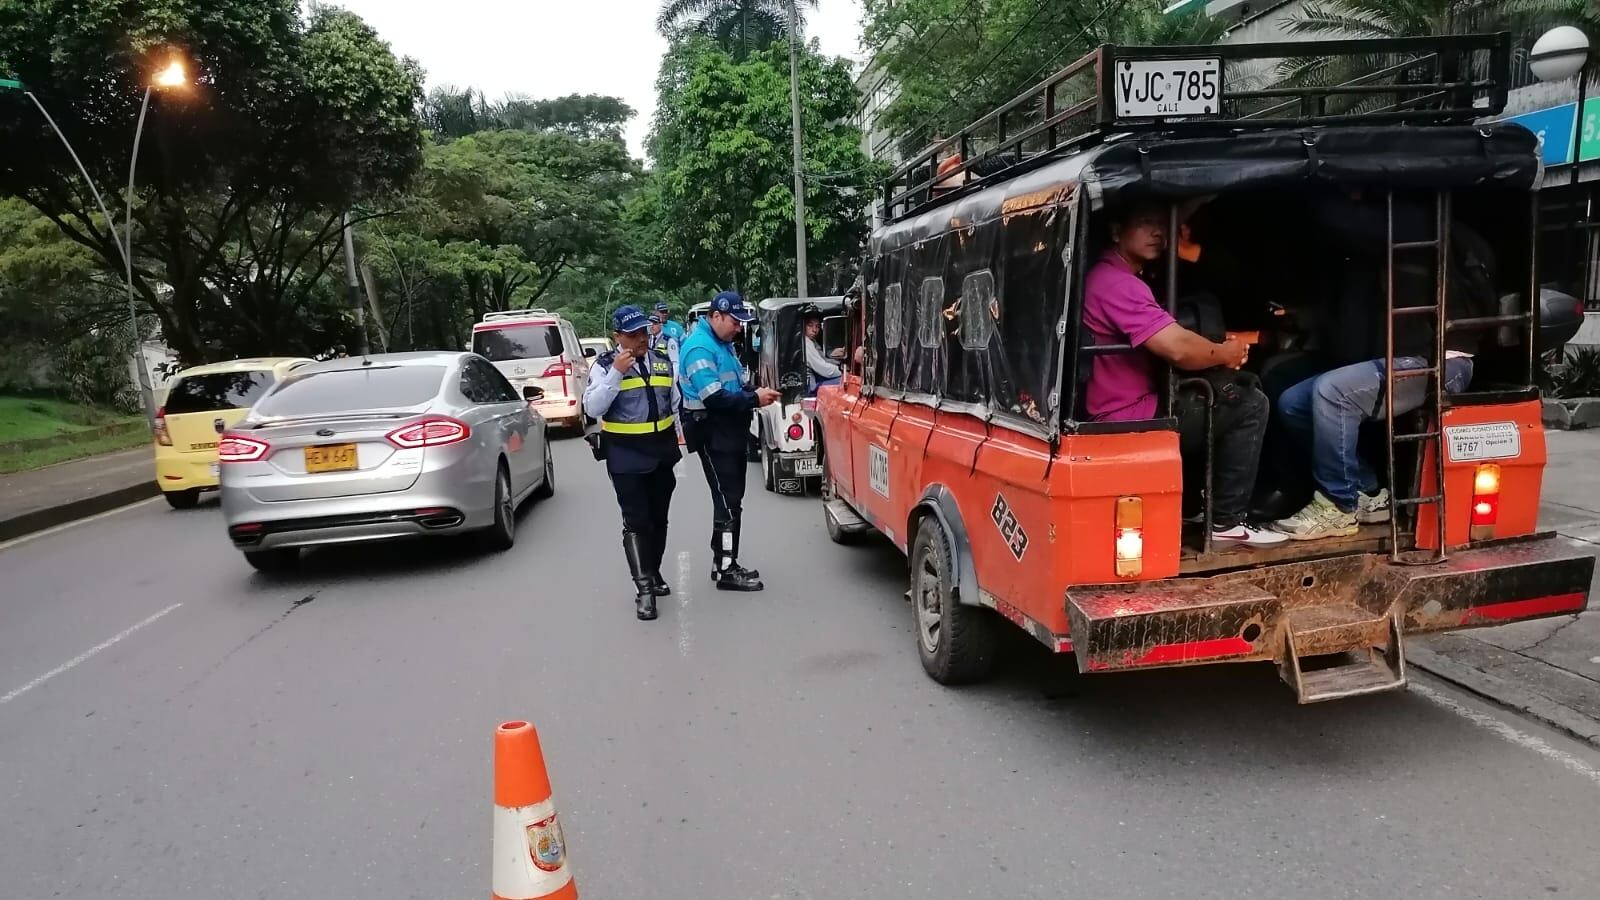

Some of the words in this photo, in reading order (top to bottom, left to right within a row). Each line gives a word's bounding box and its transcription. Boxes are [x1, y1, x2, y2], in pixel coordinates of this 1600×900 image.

[1120, 72, 1165, 103] VJC
[1172, 70, 1217, 101] 785
[1157, 103, 1179, 112] CALI
[1457, 441, 1479, 453] #767
[797, 460, 813, 470] VAH
[991, 493, 1029, 561] 823
